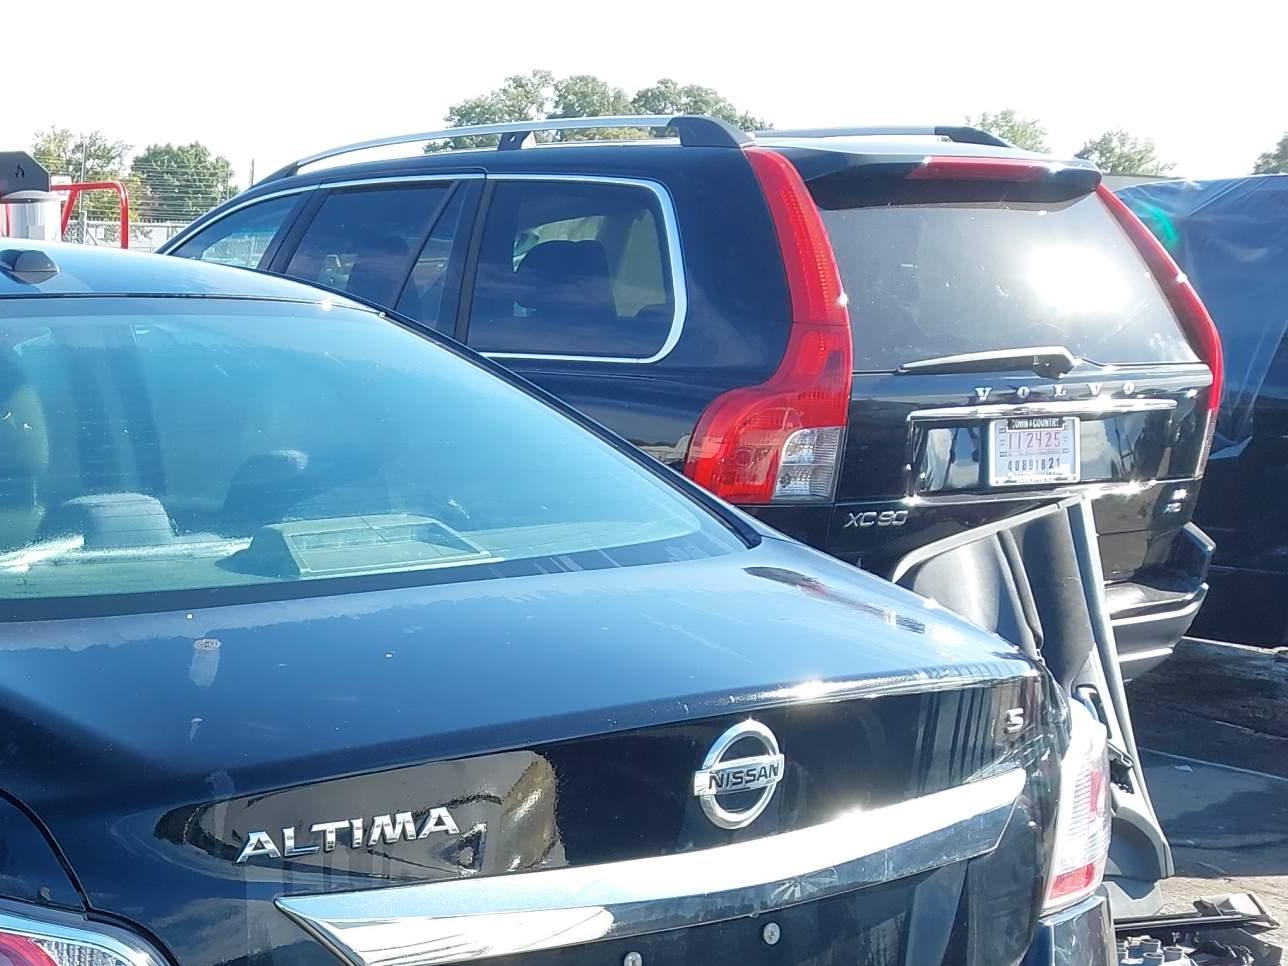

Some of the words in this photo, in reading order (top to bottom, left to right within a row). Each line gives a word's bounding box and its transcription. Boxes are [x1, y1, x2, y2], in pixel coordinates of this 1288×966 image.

[975, 381, 1135, 401] VOLVO
[843, 510, 909, 528] XC90
[1006, 707, 1024, 733] S
[708, 762, 779, 790] NISSAN
[233, 806, 460, 865] ALTIMA
